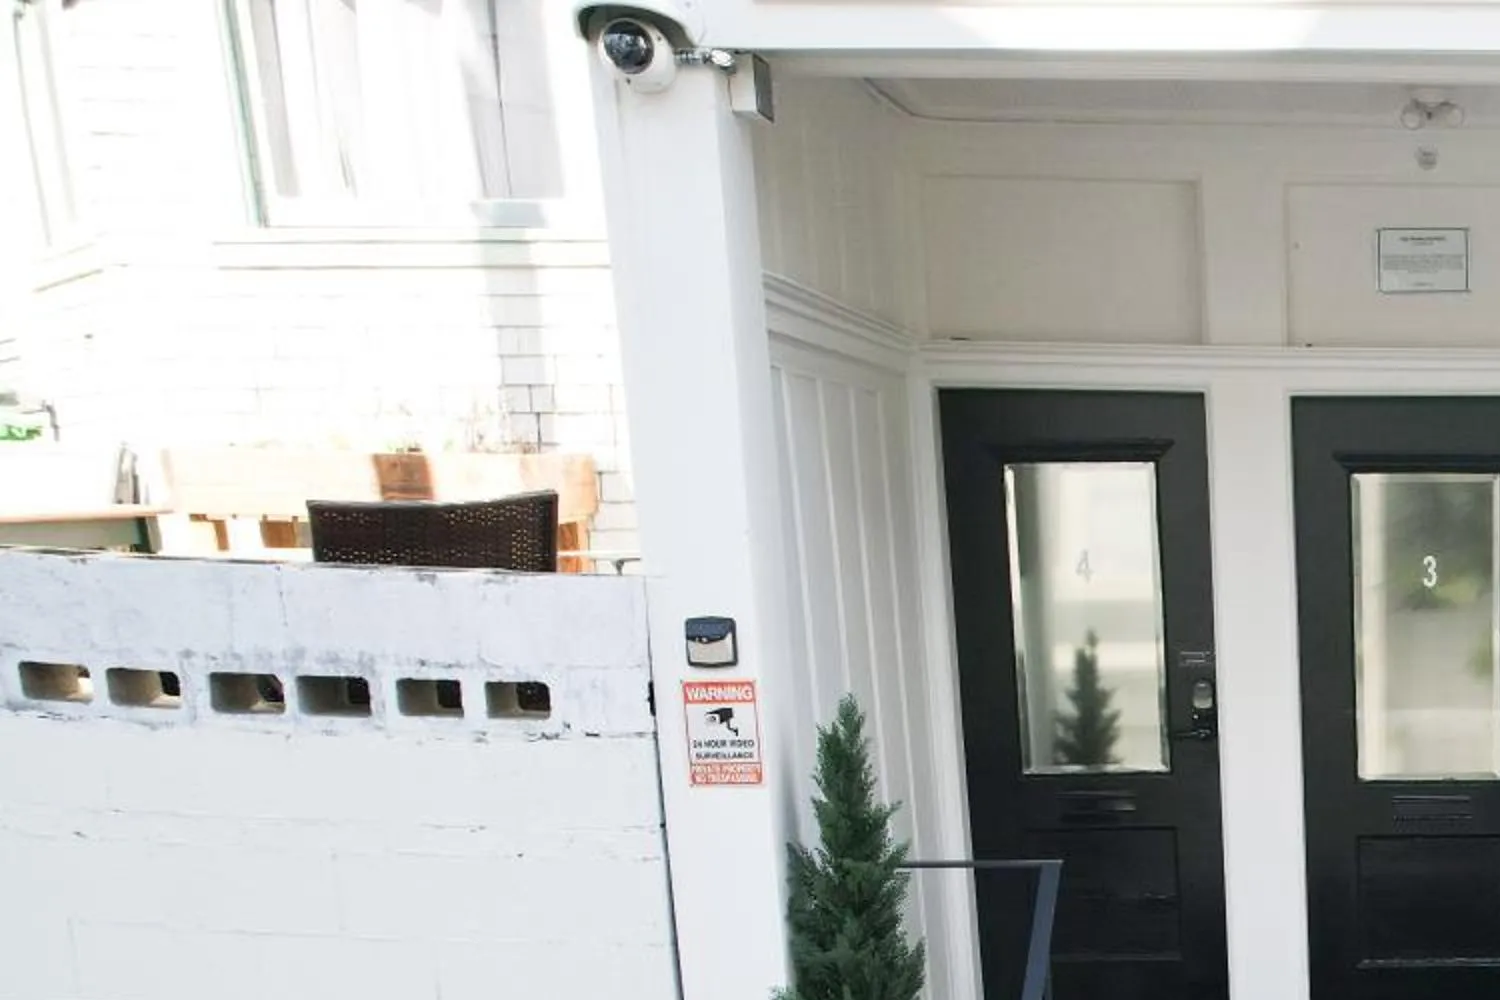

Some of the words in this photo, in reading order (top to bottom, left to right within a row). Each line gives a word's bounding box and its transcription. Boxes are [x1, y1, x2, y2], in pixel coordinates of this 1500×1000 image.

[1075, 548, 1087, 574] 4
[1423, 555, 1437, 585] 3
[686, 686, 753, 701] WARNING
[704, 739, 727, 748] HOUR
[730, 739, 754, 747] VIDEO
